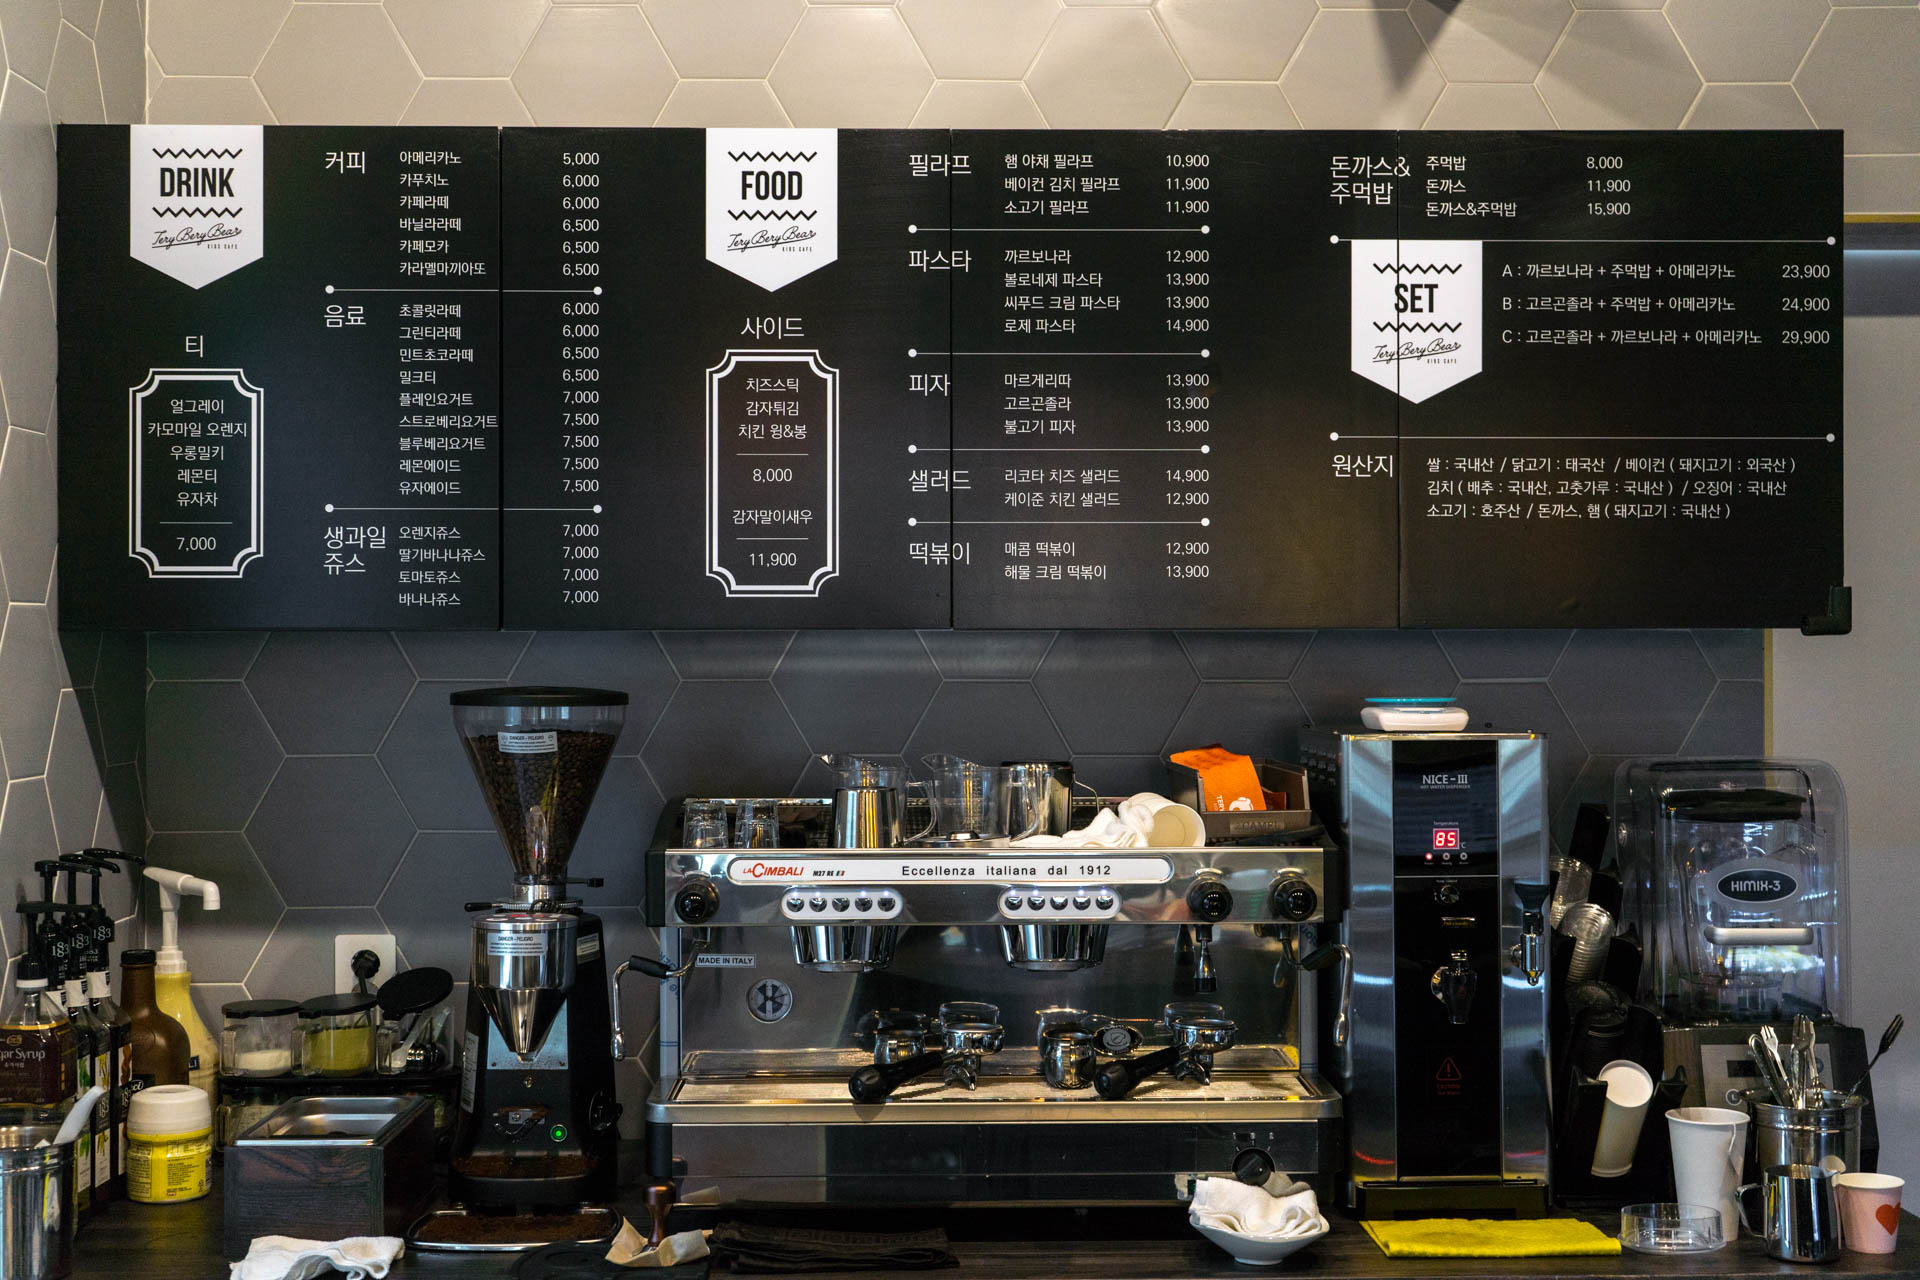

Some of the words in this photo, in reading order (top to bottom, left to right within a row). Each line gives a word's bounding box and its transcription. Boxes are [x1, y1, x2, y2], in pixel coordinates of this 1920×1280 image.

[324, 150, 366, 175] 커피
[399, 150, 462, 166] 아메리카노
[562, 152, 600, 166] 5,000
[908, 153, 972, 177] 필라프
[1004, 153, 1018, 169] 햄
[1022, 153, 1049, 169] 야채
[1053, 153, 1094, 170] 필라프
[1166, 154, 1210, 168] 10,900
[1425, 155, 1467, 172] 주먹밥
[1586, 156, 1623, 170] 8,000
[1329, 155, 1412, 179] 돈까스&
[160, 167, 234, 198] DRINK
[399, 172, 450, 188] 카푸치노
[562, 174, 600, 188] 6,000
[741, 170, 803, 201] FOOD
[1004, 176, 1045, 192] 베이컨
[1049, 176, 1076, 193] 김치
[1080, 176, 1121, 193] 필라프
[1166, 177, 1210, 191] 11,900
[1425, 178, 1467, 195] 돈까스
[1587, 179, 1631, 193] 11,900
[1329, 181, 1394, 206] 주먹밥
[399, 195, 449, 210] 카페라떼
[562, 196, 600, 211] 6,000
[1004, 199, 1044, 216] 소고기
[1048, 200, 1090, 216] 필라프
[1166, 200, 1210, 214] 11,900
[1425, 201, 1518, 218] 돈까스&주먹밥
[1587, 202, 1631, 216] 15,900
[399, 217, 462, 232] 바닐라라떼
[562, 218, 600, 233] 6,500
[399, 239, 450, 254] 카페모카
[562, 240, 600, 255] 6,500
[908, 249, 972, 273] 파스타
[1004, 249, 1072, 265] 까르보나라
[1166, 249, 1210, 264] 12,900
[399, 261, 486, 276] 카라멜마끼아또
[562, 262, 600, 277] 6,500
[1501, 263, 1513, 278] A
[1526, 263, 1594, 279] 까르보나라
[1610, 263, 1652, 279] 주먹밥
[1668, 263, 1736, 279] 아메리카노
[1782, 264, 1831, 279] 23,900
[1003, 272, 1058, 288] 볼로네제
[1062, 272, 1103, 288] 파스타
[1166, 272, 1210, 287] 13,900
[1004, 295, 1045, 311] 씨푸드
[1048, 295, 1075, 311] 크림
[1079, 295, 1121, 311] 파스타
[1166, 295, 1210, 310] 13,900
[1394, 283, 1439, 313] SET
[323, 304, 367, 328] 음료
[399, 303, 461, 319] 초콜릿라떼
[562, 302, 600, 316] 6,000
[399, 326, 461, 341] 그린티라떼
[740, 316, 805, 340] 사이드
[1003, 318, 1031, 334] 로제
[1035, 318, 1077, 334] 파스타
[1166, 318, 1210, 333] 14,900
[185, 334, 204, 358] 티
[399, 348, 474, 363] 민트초코라떼
[399, 370, 436, 385] 밀크티
[745, 377, 799, 393] 치즈스틱
[908, 373, 951, 397] 피자
[1004, 373, 1072, 389] 마르게리따
[1166, 373, 1210, 388] 13,900
[170, 399, 224, 415] 얼그레이
[399, 392, 474, 407] 플레인요거트
[1003, 396, 1072, 412] 고르곤졸라
[1166, 396, 1210, 411] 13,900
[745, 400, 799, 417] 감자튀김
[147, 422, 202, 438] 카모마일
[206, 422, 247, 438] 오렌지
[398, 415, 498, 429] 스트로베리요거트
[1003, 419, 1044, 435] 불고기
[1048, 419, 1077, 435] 피자
[1165, 419, 1210, 434] 13,900
[738, 423, 765, 440] 치킨
[769, 423, 808, 440] 윙&봉
[398, 436, 486, 451] 블루베리요거트
[170, 445, 224, 461] 우롱밀키
[399, 459, 462, 473] 레몬에이드
[1331, 454, 1393, 478] 원산지
[1426, 457, 1441, 473] 쌀
[1453, 457, 1495, 473] 국내산
[1511, 457, 1551, 473] 닭고기
[1565, 457, 1606, 473] 태국산
[1625, 457, 1665, 473] 베이컨
[1679, 457, 1732, 473] 돼지고기
[1746, 458, 1786, 473] 외국산
[177, 468, 217, 484] 레몬티
[752, 468, 793, 484] 8,000
[908, 468, 972, 493] 샐러드
[1004, 468, 1045, 485] 리코타
[1049, 468, 1076, 485] 치즈
[1080, 468, 1121, 485] 샐러드
[1165, 469, 1210, 483] 14,900
[398, 481, 462, 496] 유자에이드
[176, 491, 219, 507] 유자차
[1004, 491, 1045, 508] 케이준
[1048, 491, 1076, 508] 치킨
[1079, 491, 1121, 508] 샐러드
[1165, 491, 1210, 507] 12,900
[732, 509, 814, 525] 감자말이새우
[323, 525, 387, 550] 생과일
[398, 526, 461, 541] 오렌지쥬스
[562, 525, 600, 539] 7,000
[176, 537, 217, 552] 7,000
[1004, 541, 1032, 558] 매콤
[1035, 541, 1076, 558] 떡볶이
[1165, 541, 1210, 556] 12,900
[398, 548, 486, 563] 딸기바나나쥬스
[749, 552, 798, 568] 11,900
[909, 541, 970, 566] 떡볶이
[323, 552, 367, 576] 쥬스
[398, 570, 461, 585] 토마토쥬스
[1004, 564, 1032, 581] 해물
[1035, 564, 1062, 581] 크림
[1067, 564, 1107, 581] 떡볶이
[1165, 564, 1210, 579] 13,900
[398, 592, 461, 607] 바나나쥬스
[1435, 831, 1457, 847] 85
[902, 865, 975, 876] Eccellenza
[986, 865, 1036, 876] italiana
[1047, 865, 1067, 876] dal
[1079, 865, 1111, 876] 1912
[1731, 880, 1781, 891] HIMIX-3
[698, 956, 721, 966] MADE
[722, 956, 731, 966] IN
[731, 956, 754, 966] ITALY
[15, 1048, 46, 1062] Syrup
